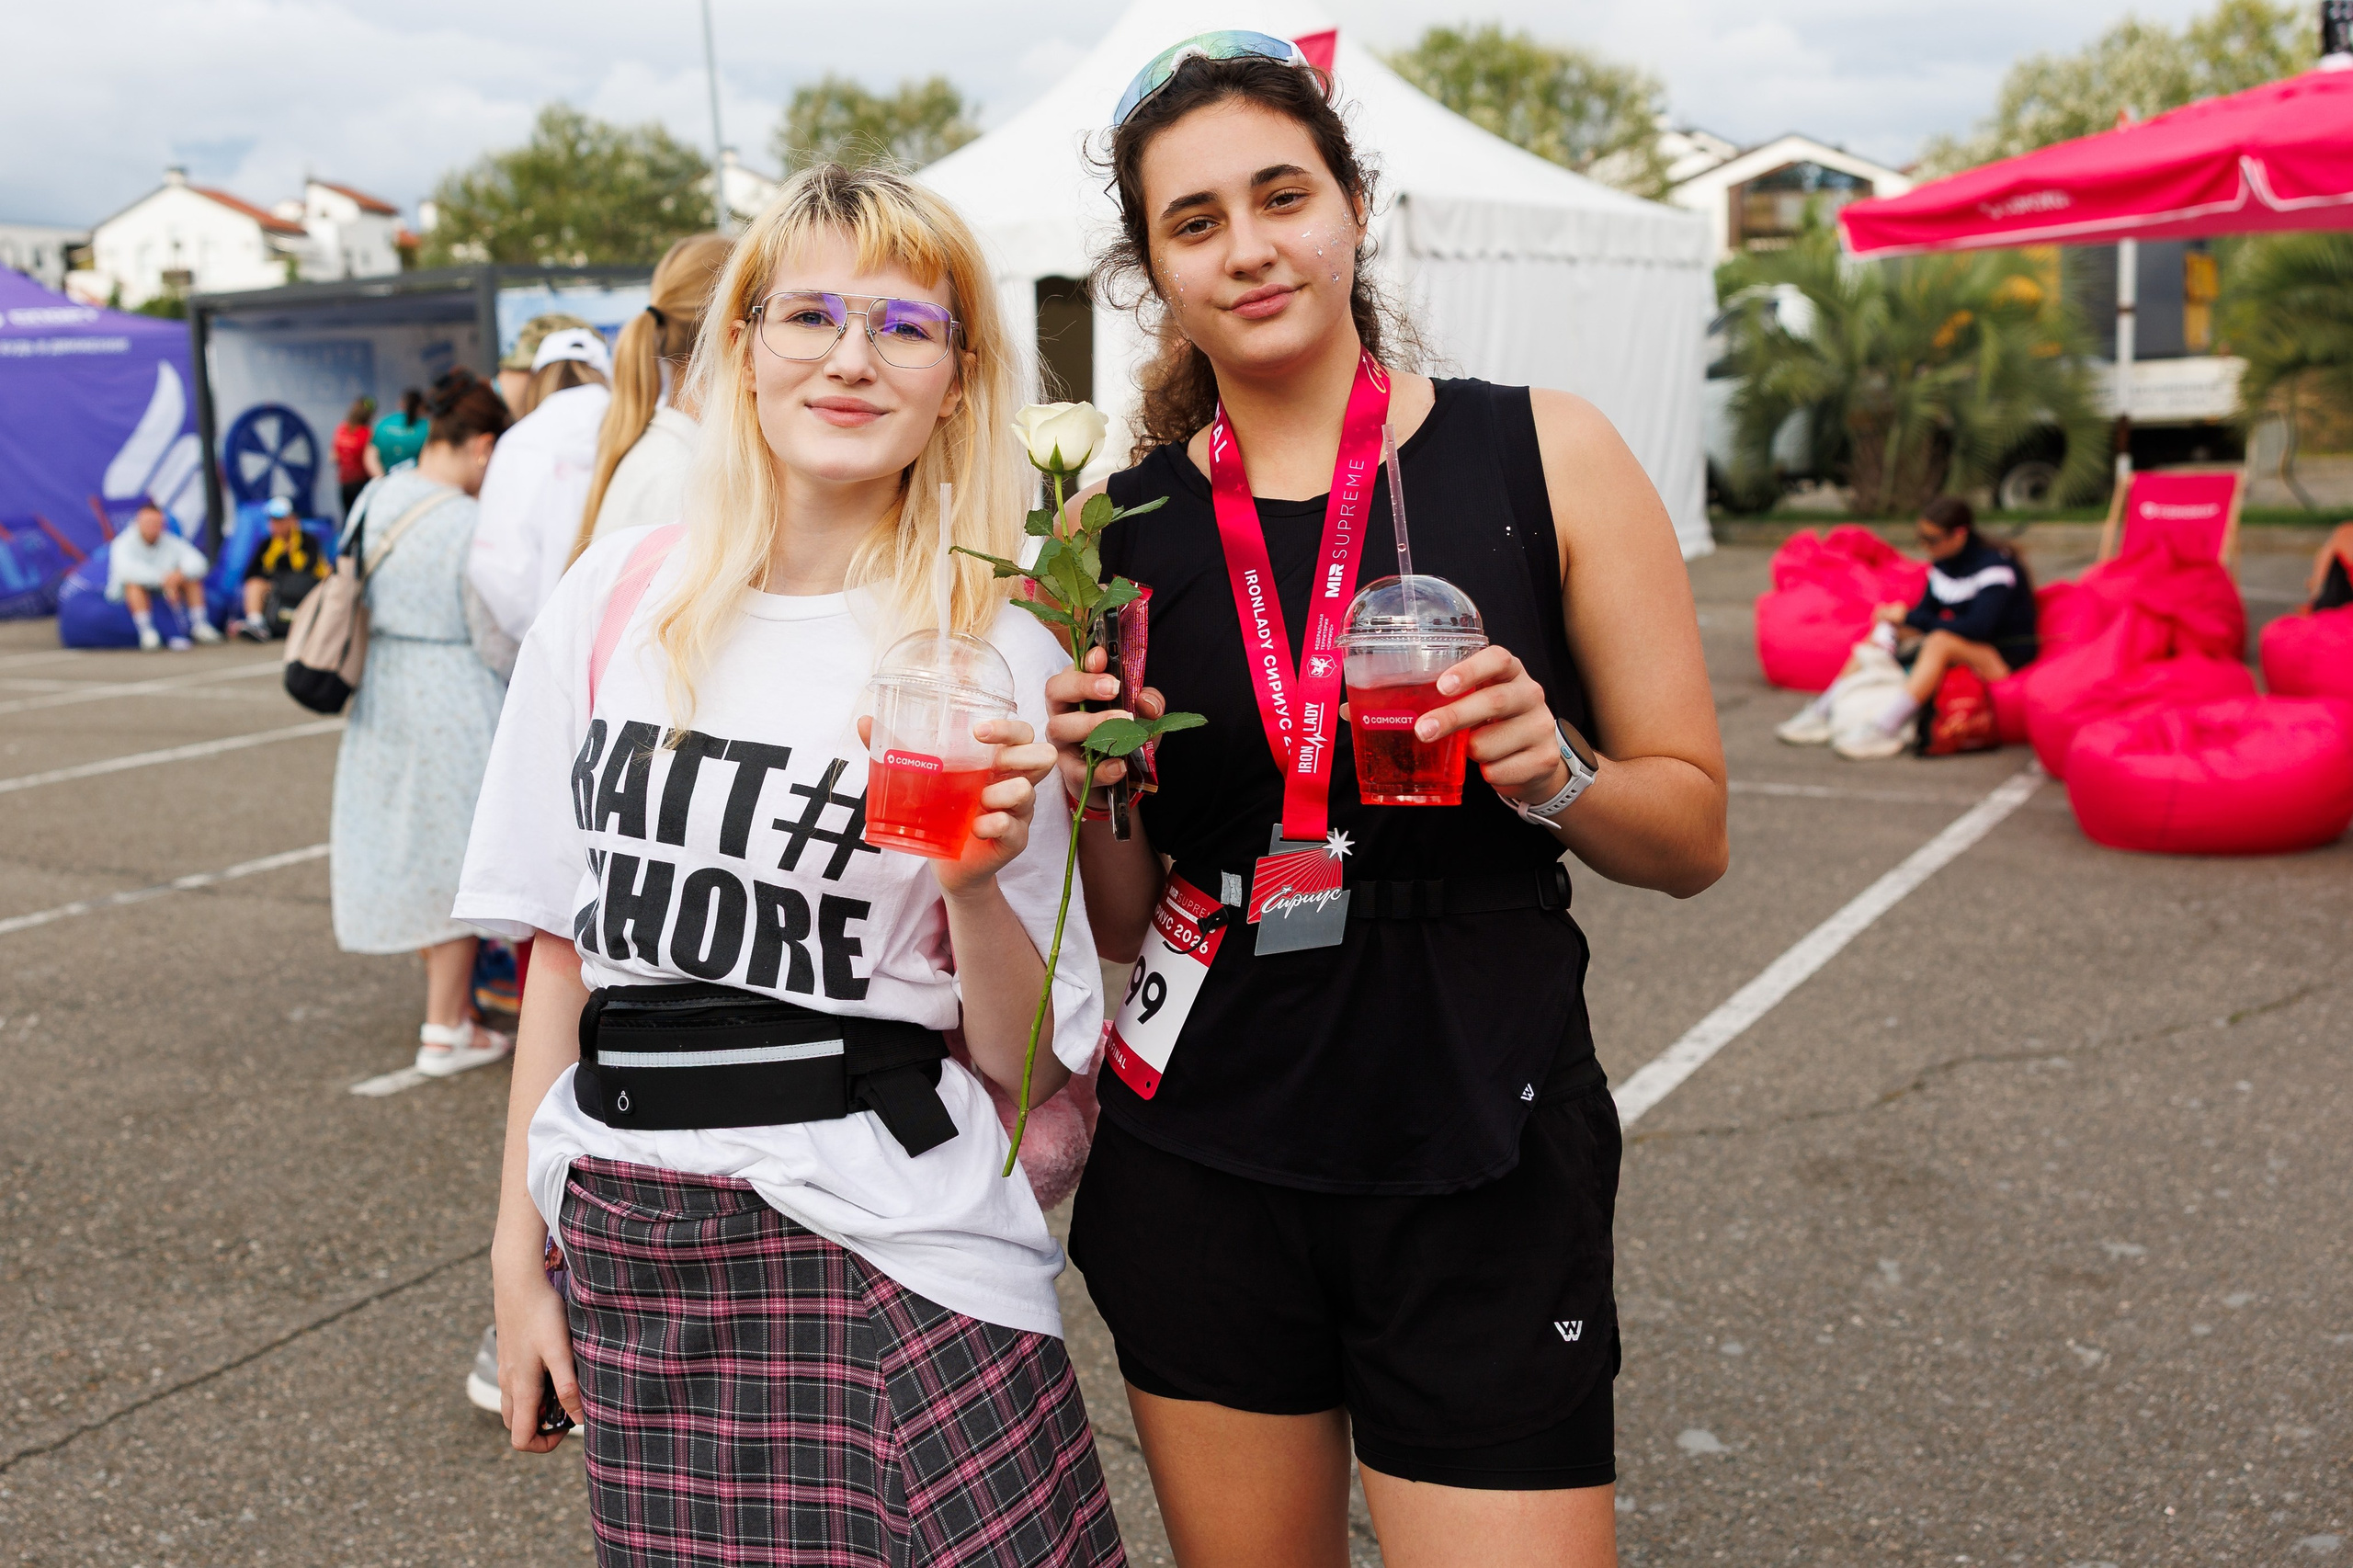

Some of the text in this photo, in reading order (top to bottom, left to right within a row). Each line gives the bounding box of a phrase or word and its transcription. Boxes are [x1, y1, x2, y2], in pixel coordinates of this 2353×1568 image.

[1324, 459, 1365, 598] MIR SUPREME
[1314, 613, 1324, 651] ФЕДЕРАЛЬНАЯ
[1321, 618, 1329, 651] ТЕРРИТОРИЯ
[1244, 568, 1293, 731] IRONLADY СИРИУС
[1370, 716, 1414, 724] самокат
[1298, 702, 1319, 773] IRON LADY
[895, 756, 938, 771] самокат
[1173, 925, 1209, 954] 2026
[1110, 1043, 1127, 1070] FINAL
